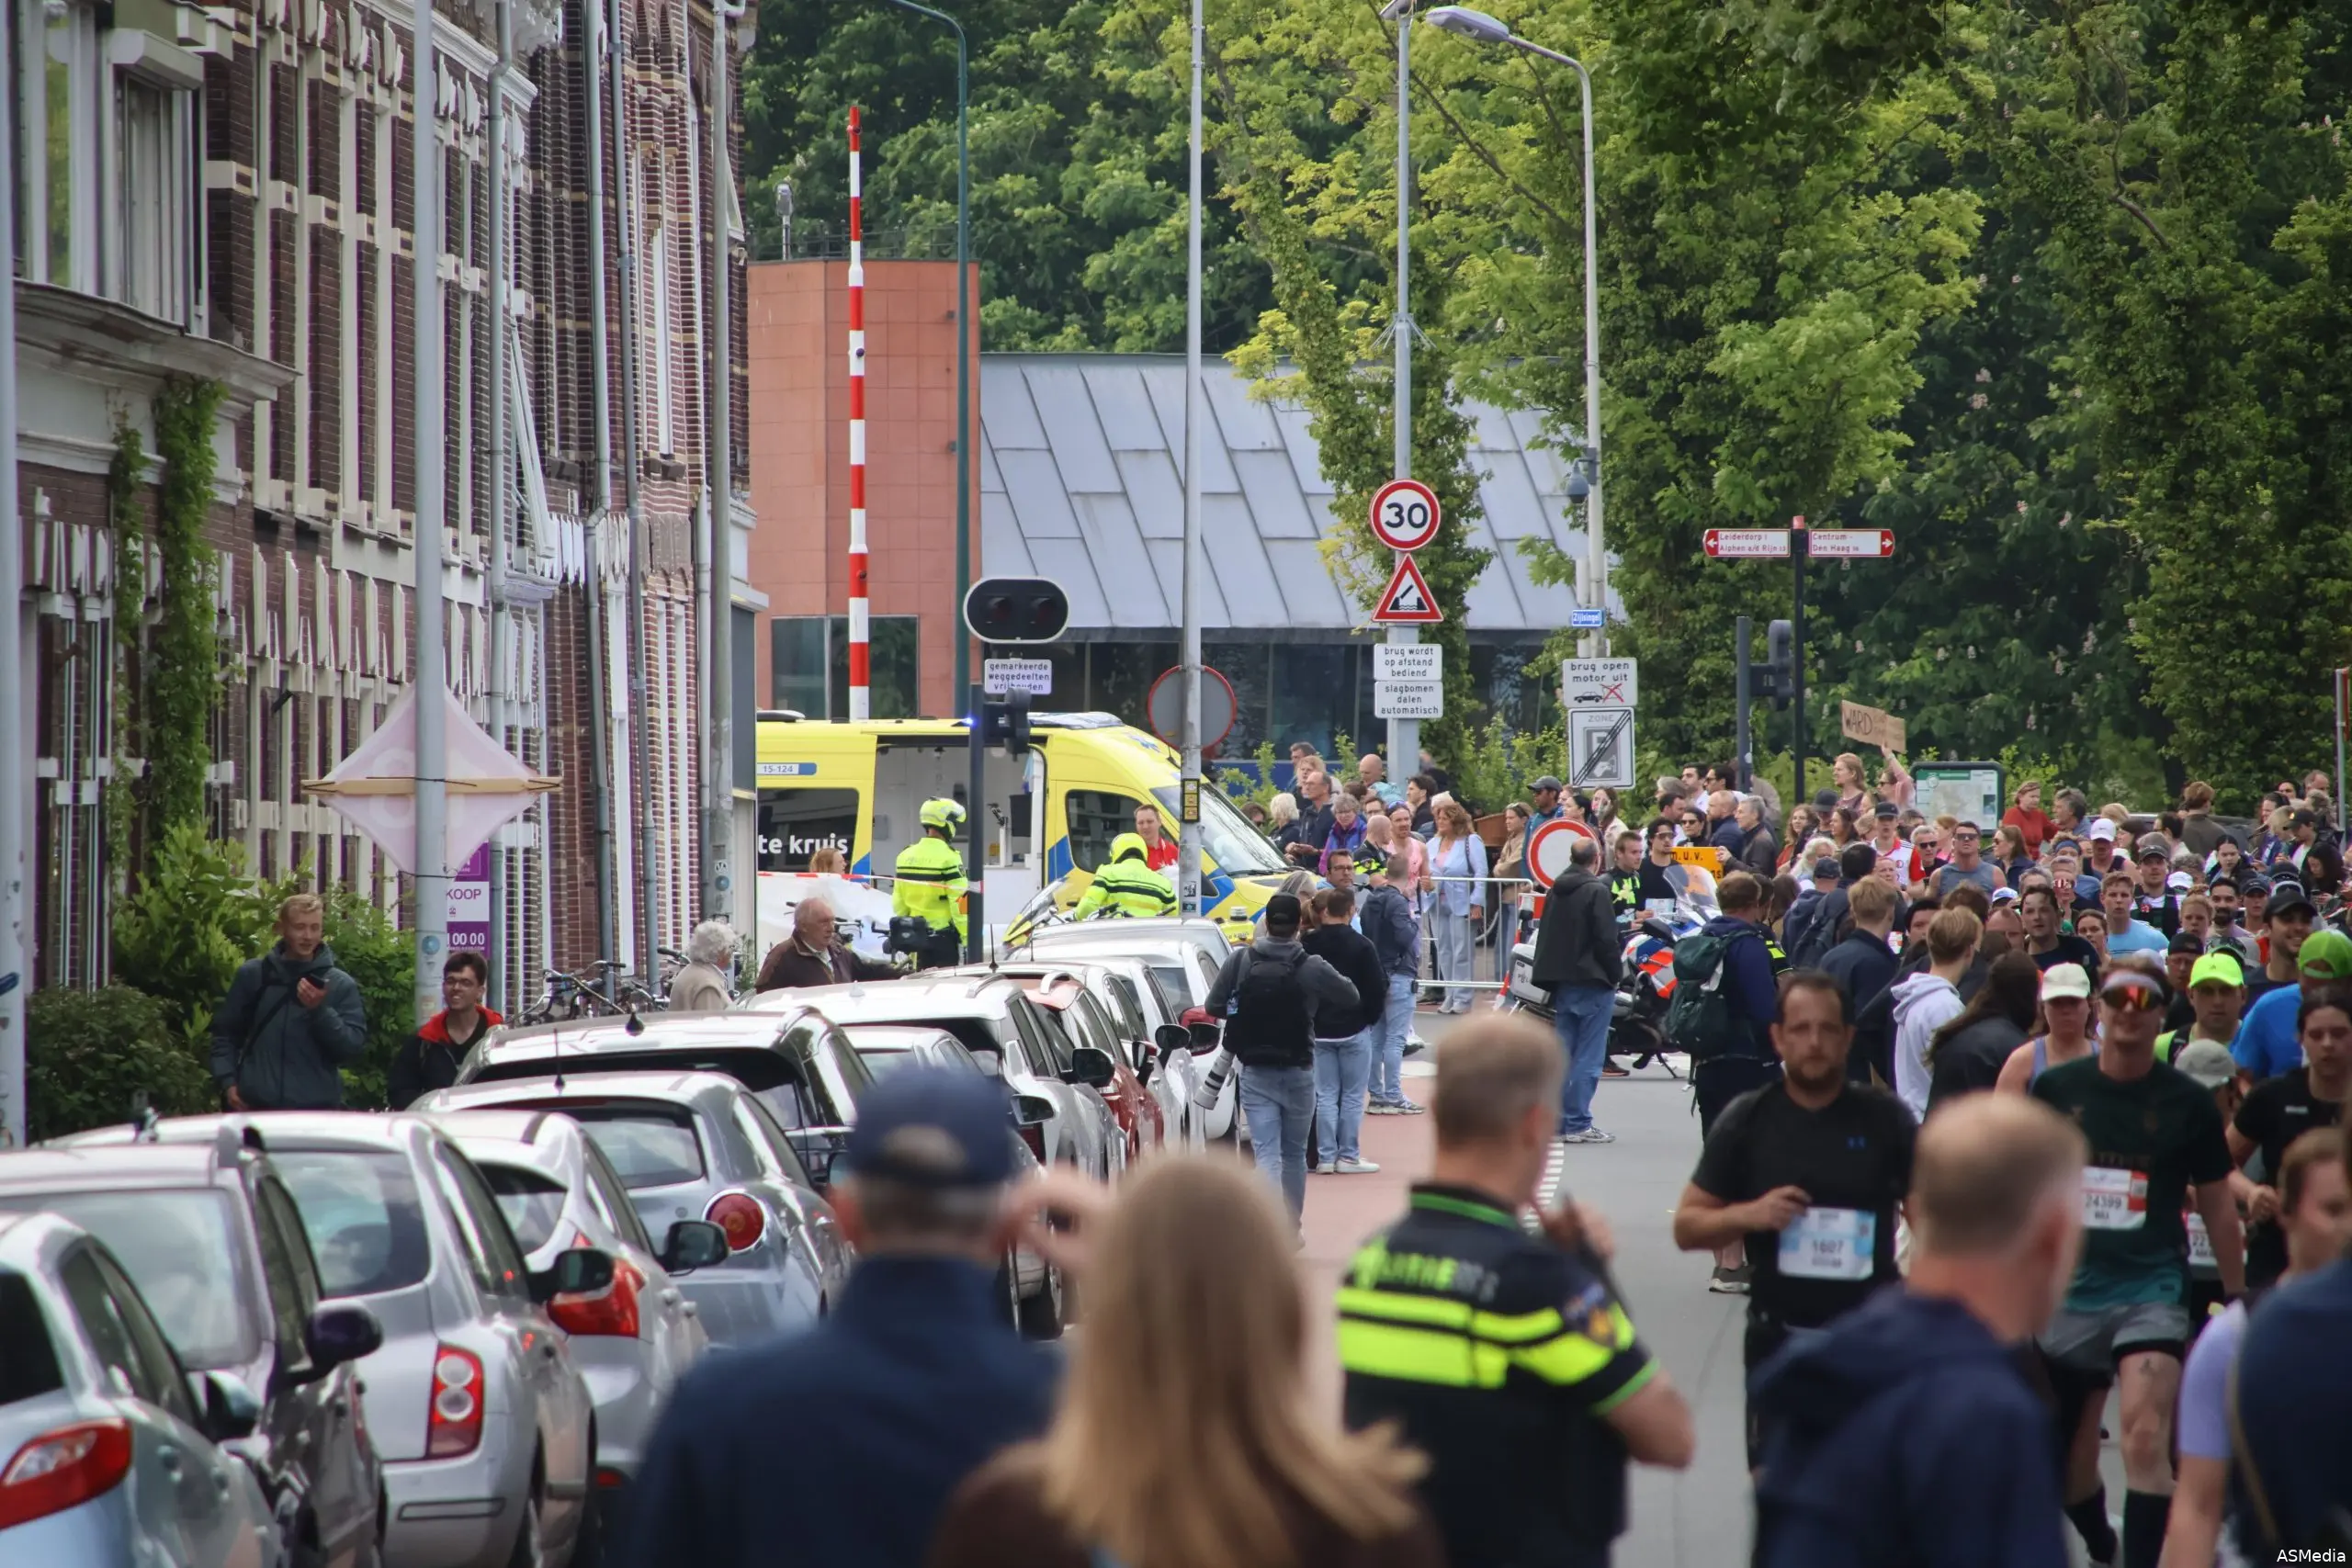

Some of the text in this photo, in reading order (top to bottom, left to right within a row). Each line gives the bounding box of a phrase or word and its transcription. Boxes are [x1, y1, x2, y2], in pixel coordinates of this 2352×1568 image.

[1385, 502, 1429, 529] 30
[1719, 533, 1763, 541] Leiderdorp
[1762, 545, 1778, 553] Rijn
[1830, 545, 1850, 553] Haag
[1385, 647, 1434, 657] brug wordt
[989, 662, 1048, 671] gemarkeerde
[1397, 658, 1433, 666] afstand
[1570, 661, 1630, 672] brug open
[988, 672, 1050, 682] weggedeelten
[1391, 669, 1427, 677] bediend
[1572, 673, 1628, 682] motor uit
[1385, 684, 1434, 694] slagbomen
[1396, 695, 1422, 704] dalen
[1381, 705, 1439, 715] automatisch
[1588, 714, 1614, 723] ZONE
[763, 765, 793, 773] 15-124
[789, 832, 848, 854] kruis
[446, 888, 481, 899] KOOP
